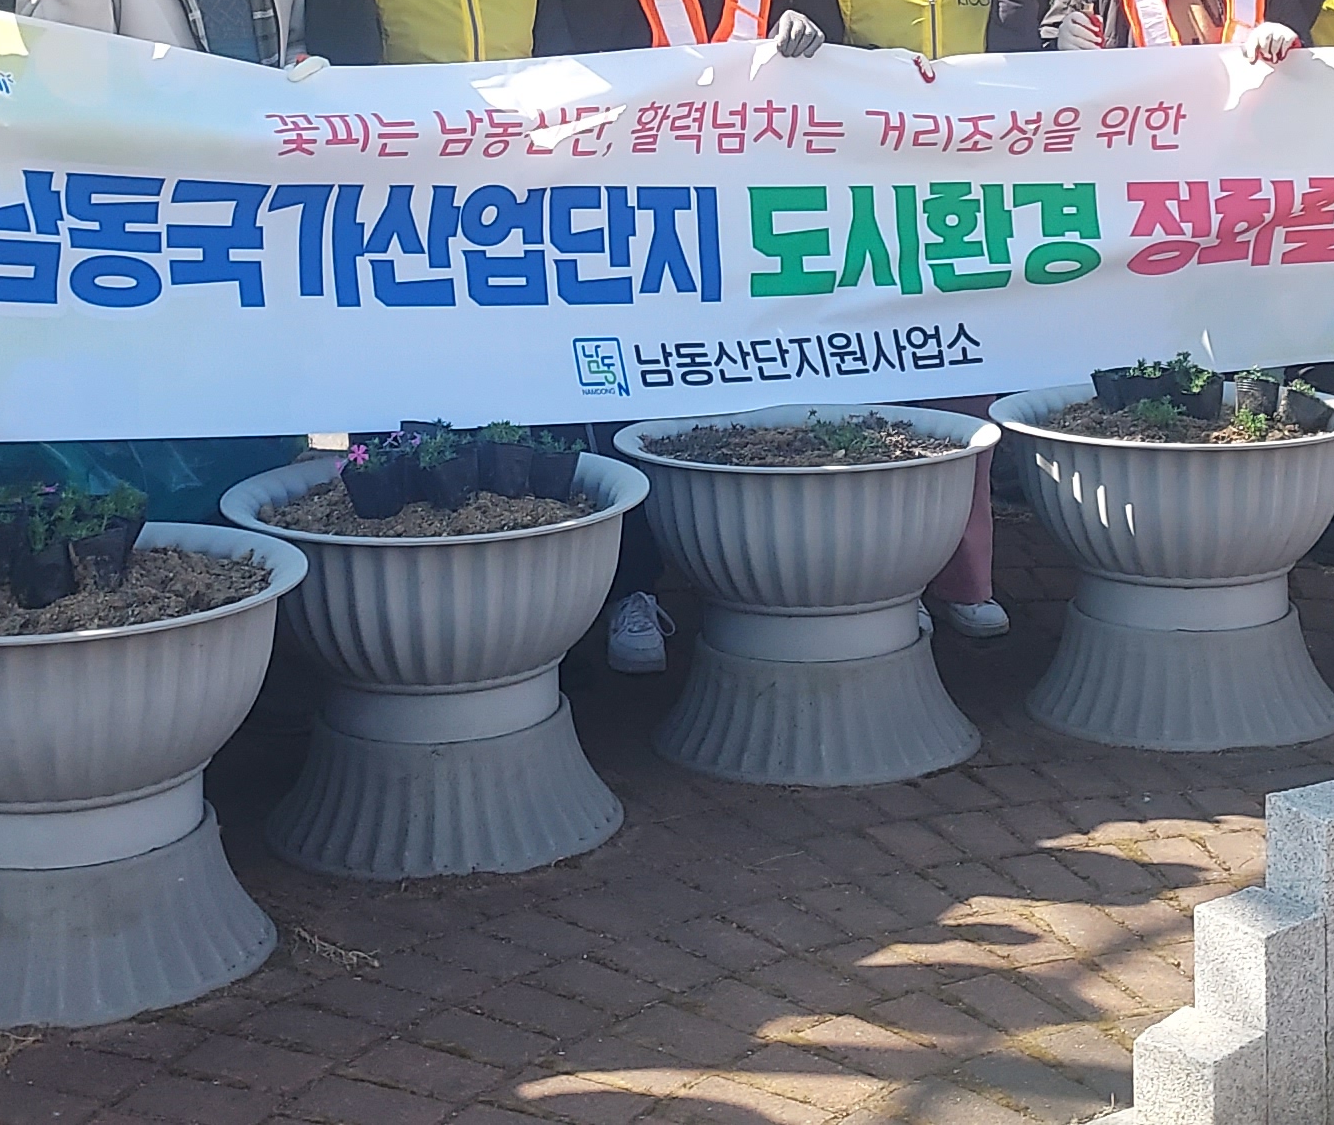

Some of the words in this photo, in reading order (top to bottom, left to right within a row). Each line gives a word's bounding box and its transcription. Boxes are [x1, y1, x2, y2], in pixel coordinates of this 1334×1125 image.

[264, 111, 420, 159] 꽃피는
[432, 106, 613, 160] 남동산단,
[630, 100, 846, 156] 활력넘치는
[865, 106, 1082, 156] 거리조성을
[1096, 100, 1188, 154] 위한
[747, 180, 1103, 300] 도시환경
[634, 322, 984, 389] 남동산단지원사업소
